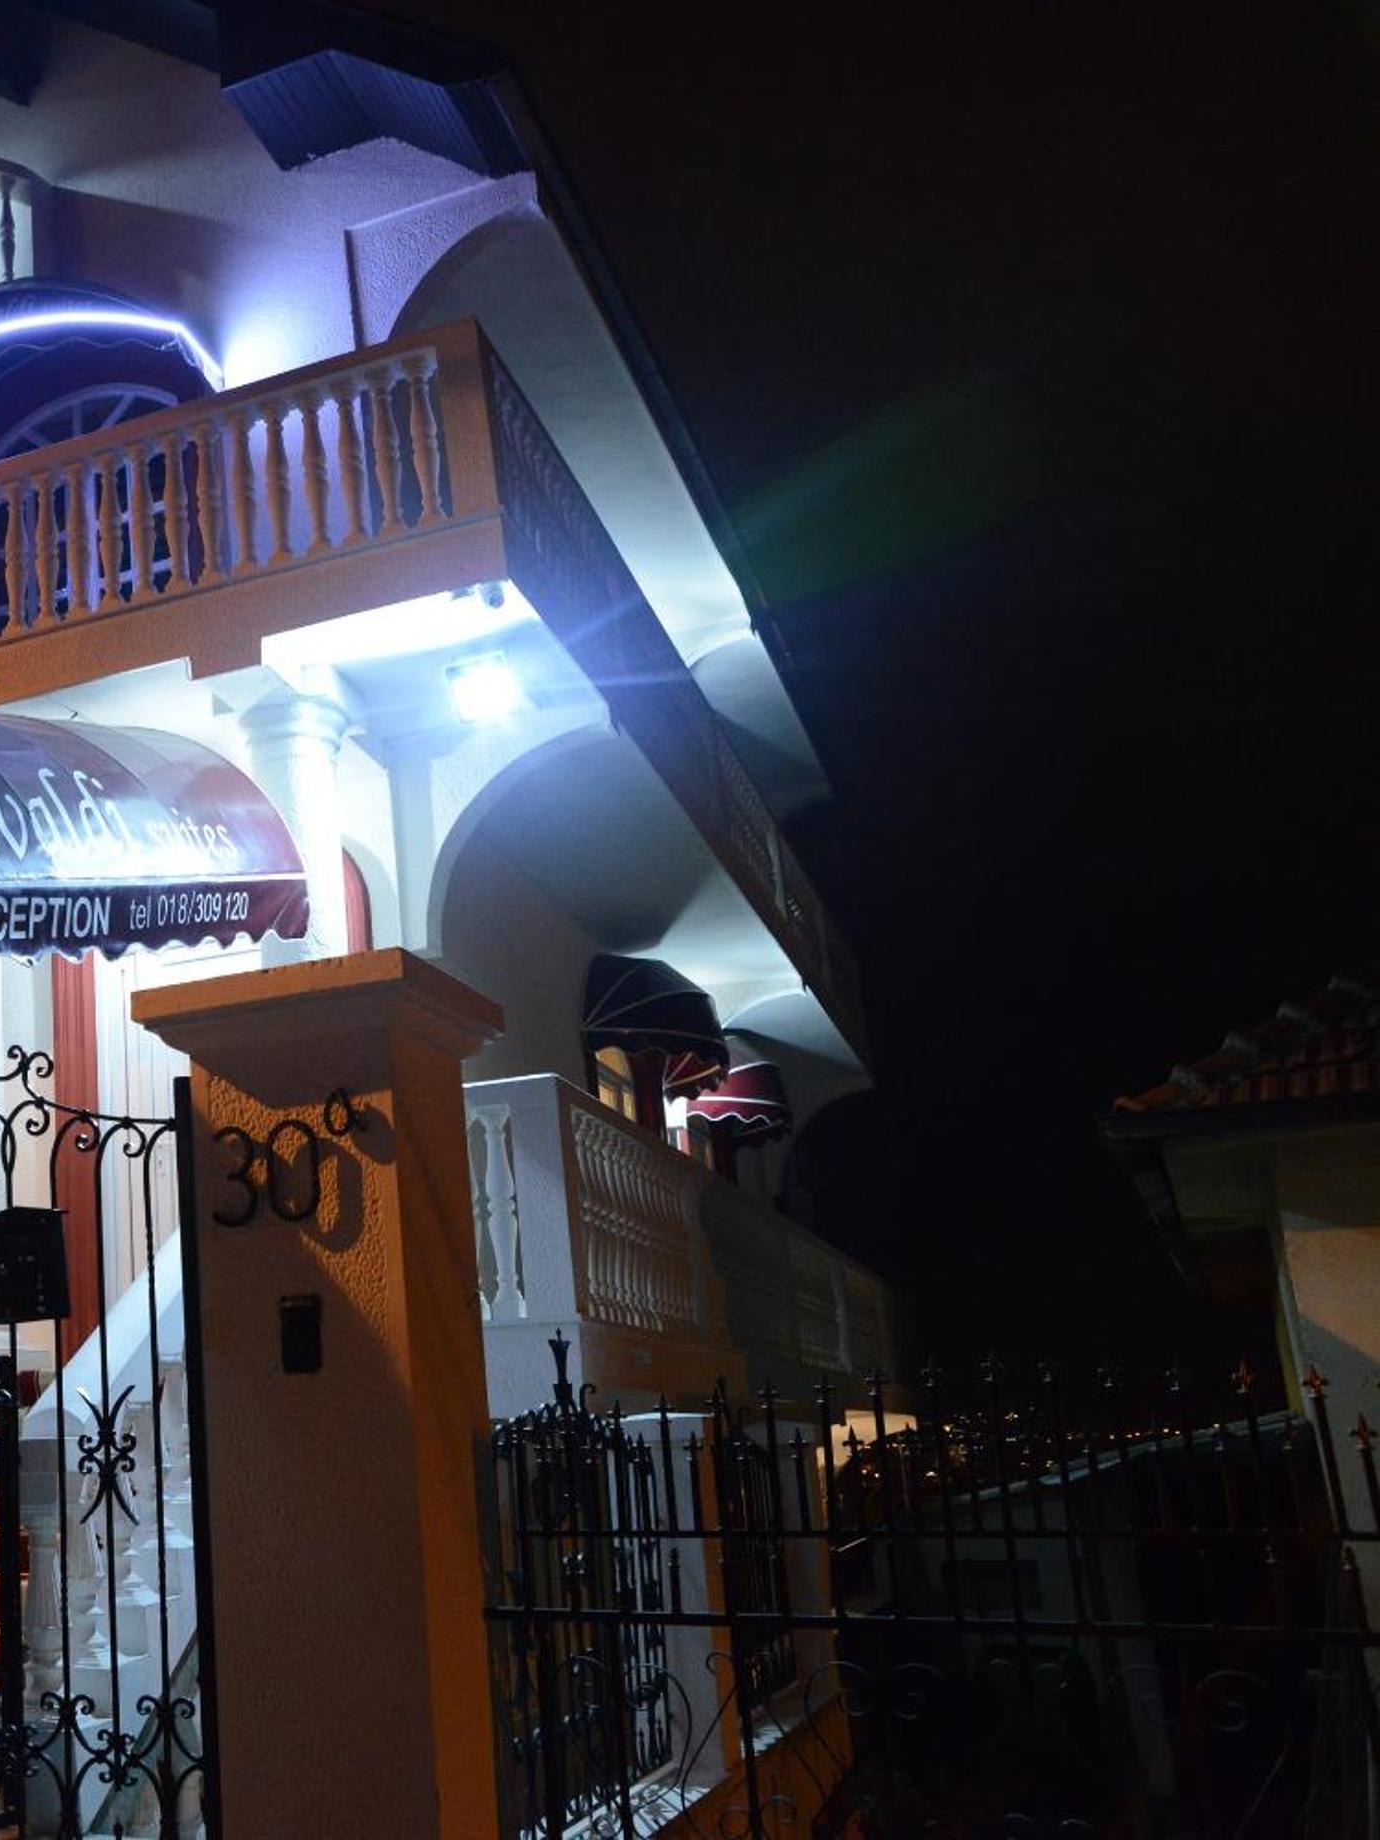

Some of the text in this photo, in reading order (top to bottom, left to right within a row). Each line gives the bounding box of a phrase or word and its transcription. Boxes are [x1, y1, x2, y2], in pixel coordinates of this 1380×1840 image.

[147, 807, 240, 862] suites
[129, 899, 151, 930] tel
[158, 890, 221, 926] 018/309
[226, 891, 249, 921] 120
